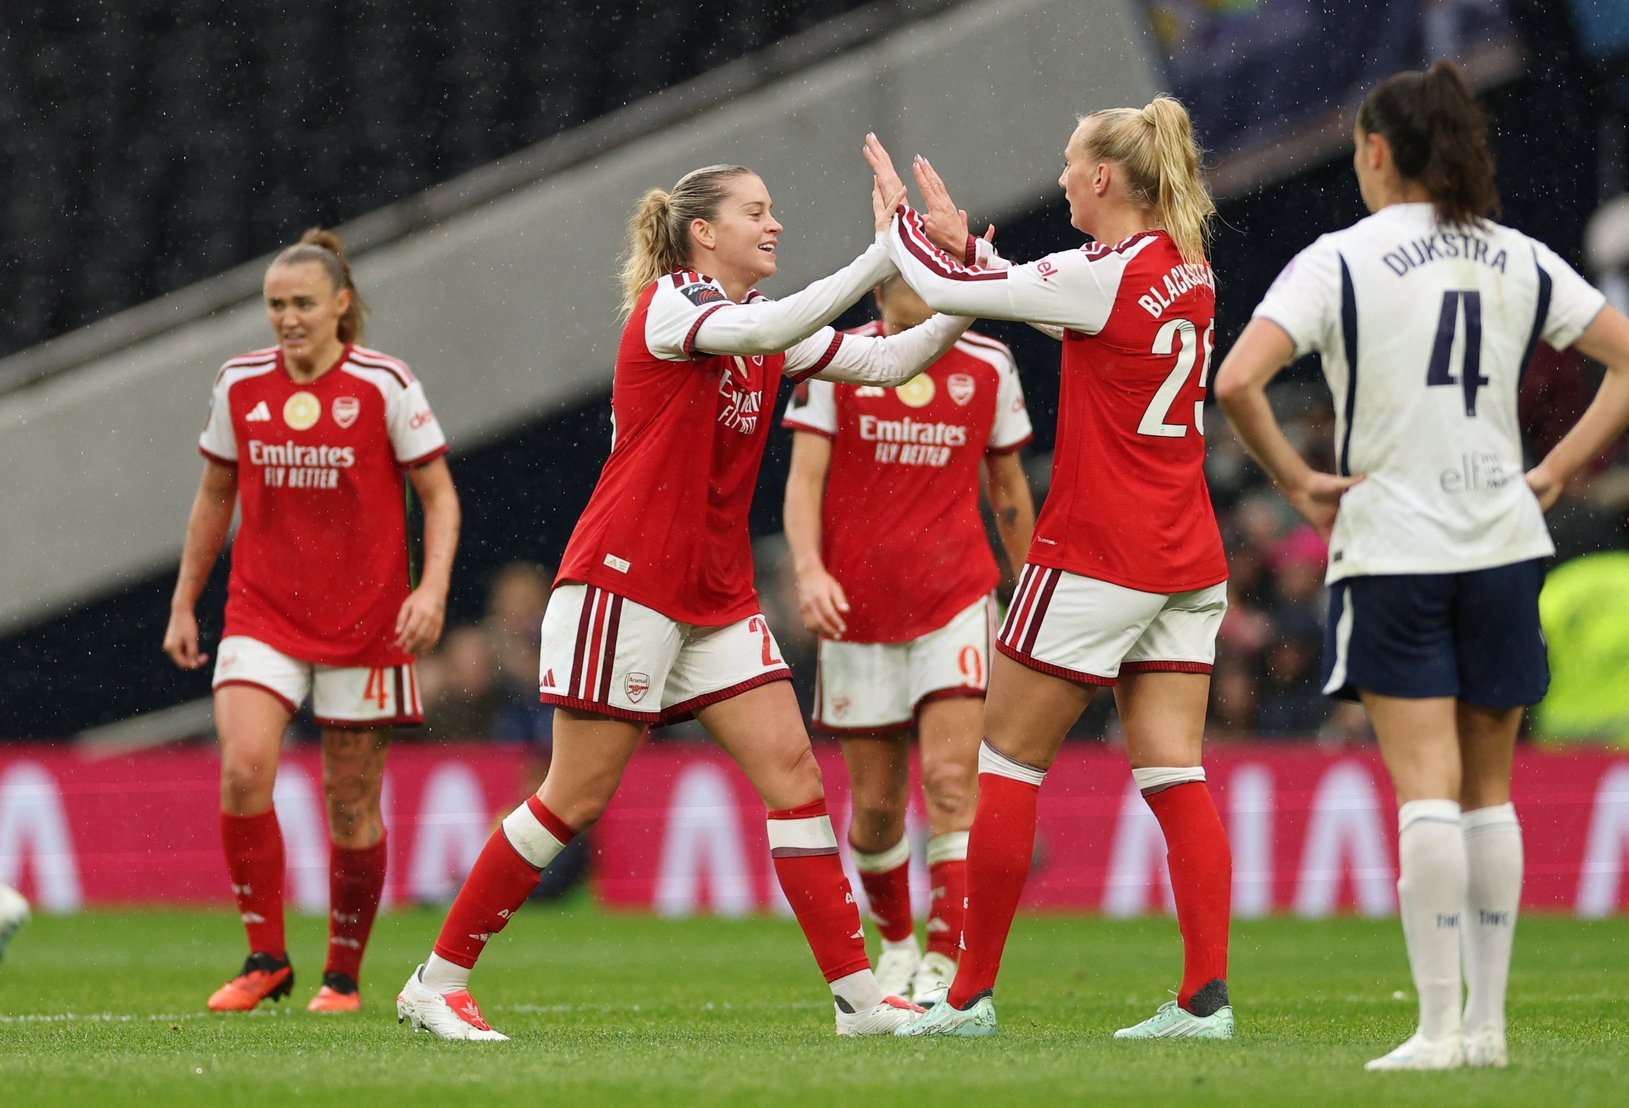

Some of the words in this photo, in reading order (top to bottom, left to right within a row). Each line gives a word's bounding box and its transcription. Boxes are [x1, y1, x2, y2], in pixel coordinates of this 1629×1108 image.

[1383, 234, 1507, 277] DIJKSTRA
[1427, 290, 1489, 417] 4
[859, 414, 967, 447] Emirates
[248, 440, 355, 468] Emirates
[875, 442, 900, 464] FLY
[899, 443, 952, 467] BETTER
[264, 467, 286, 488] FLY
[288, 468, 340, 489] BETTER
[748, 617, 781, 667] 2
[957, 645, 983, 687] 9
[363, 667, 388, 710] 4
